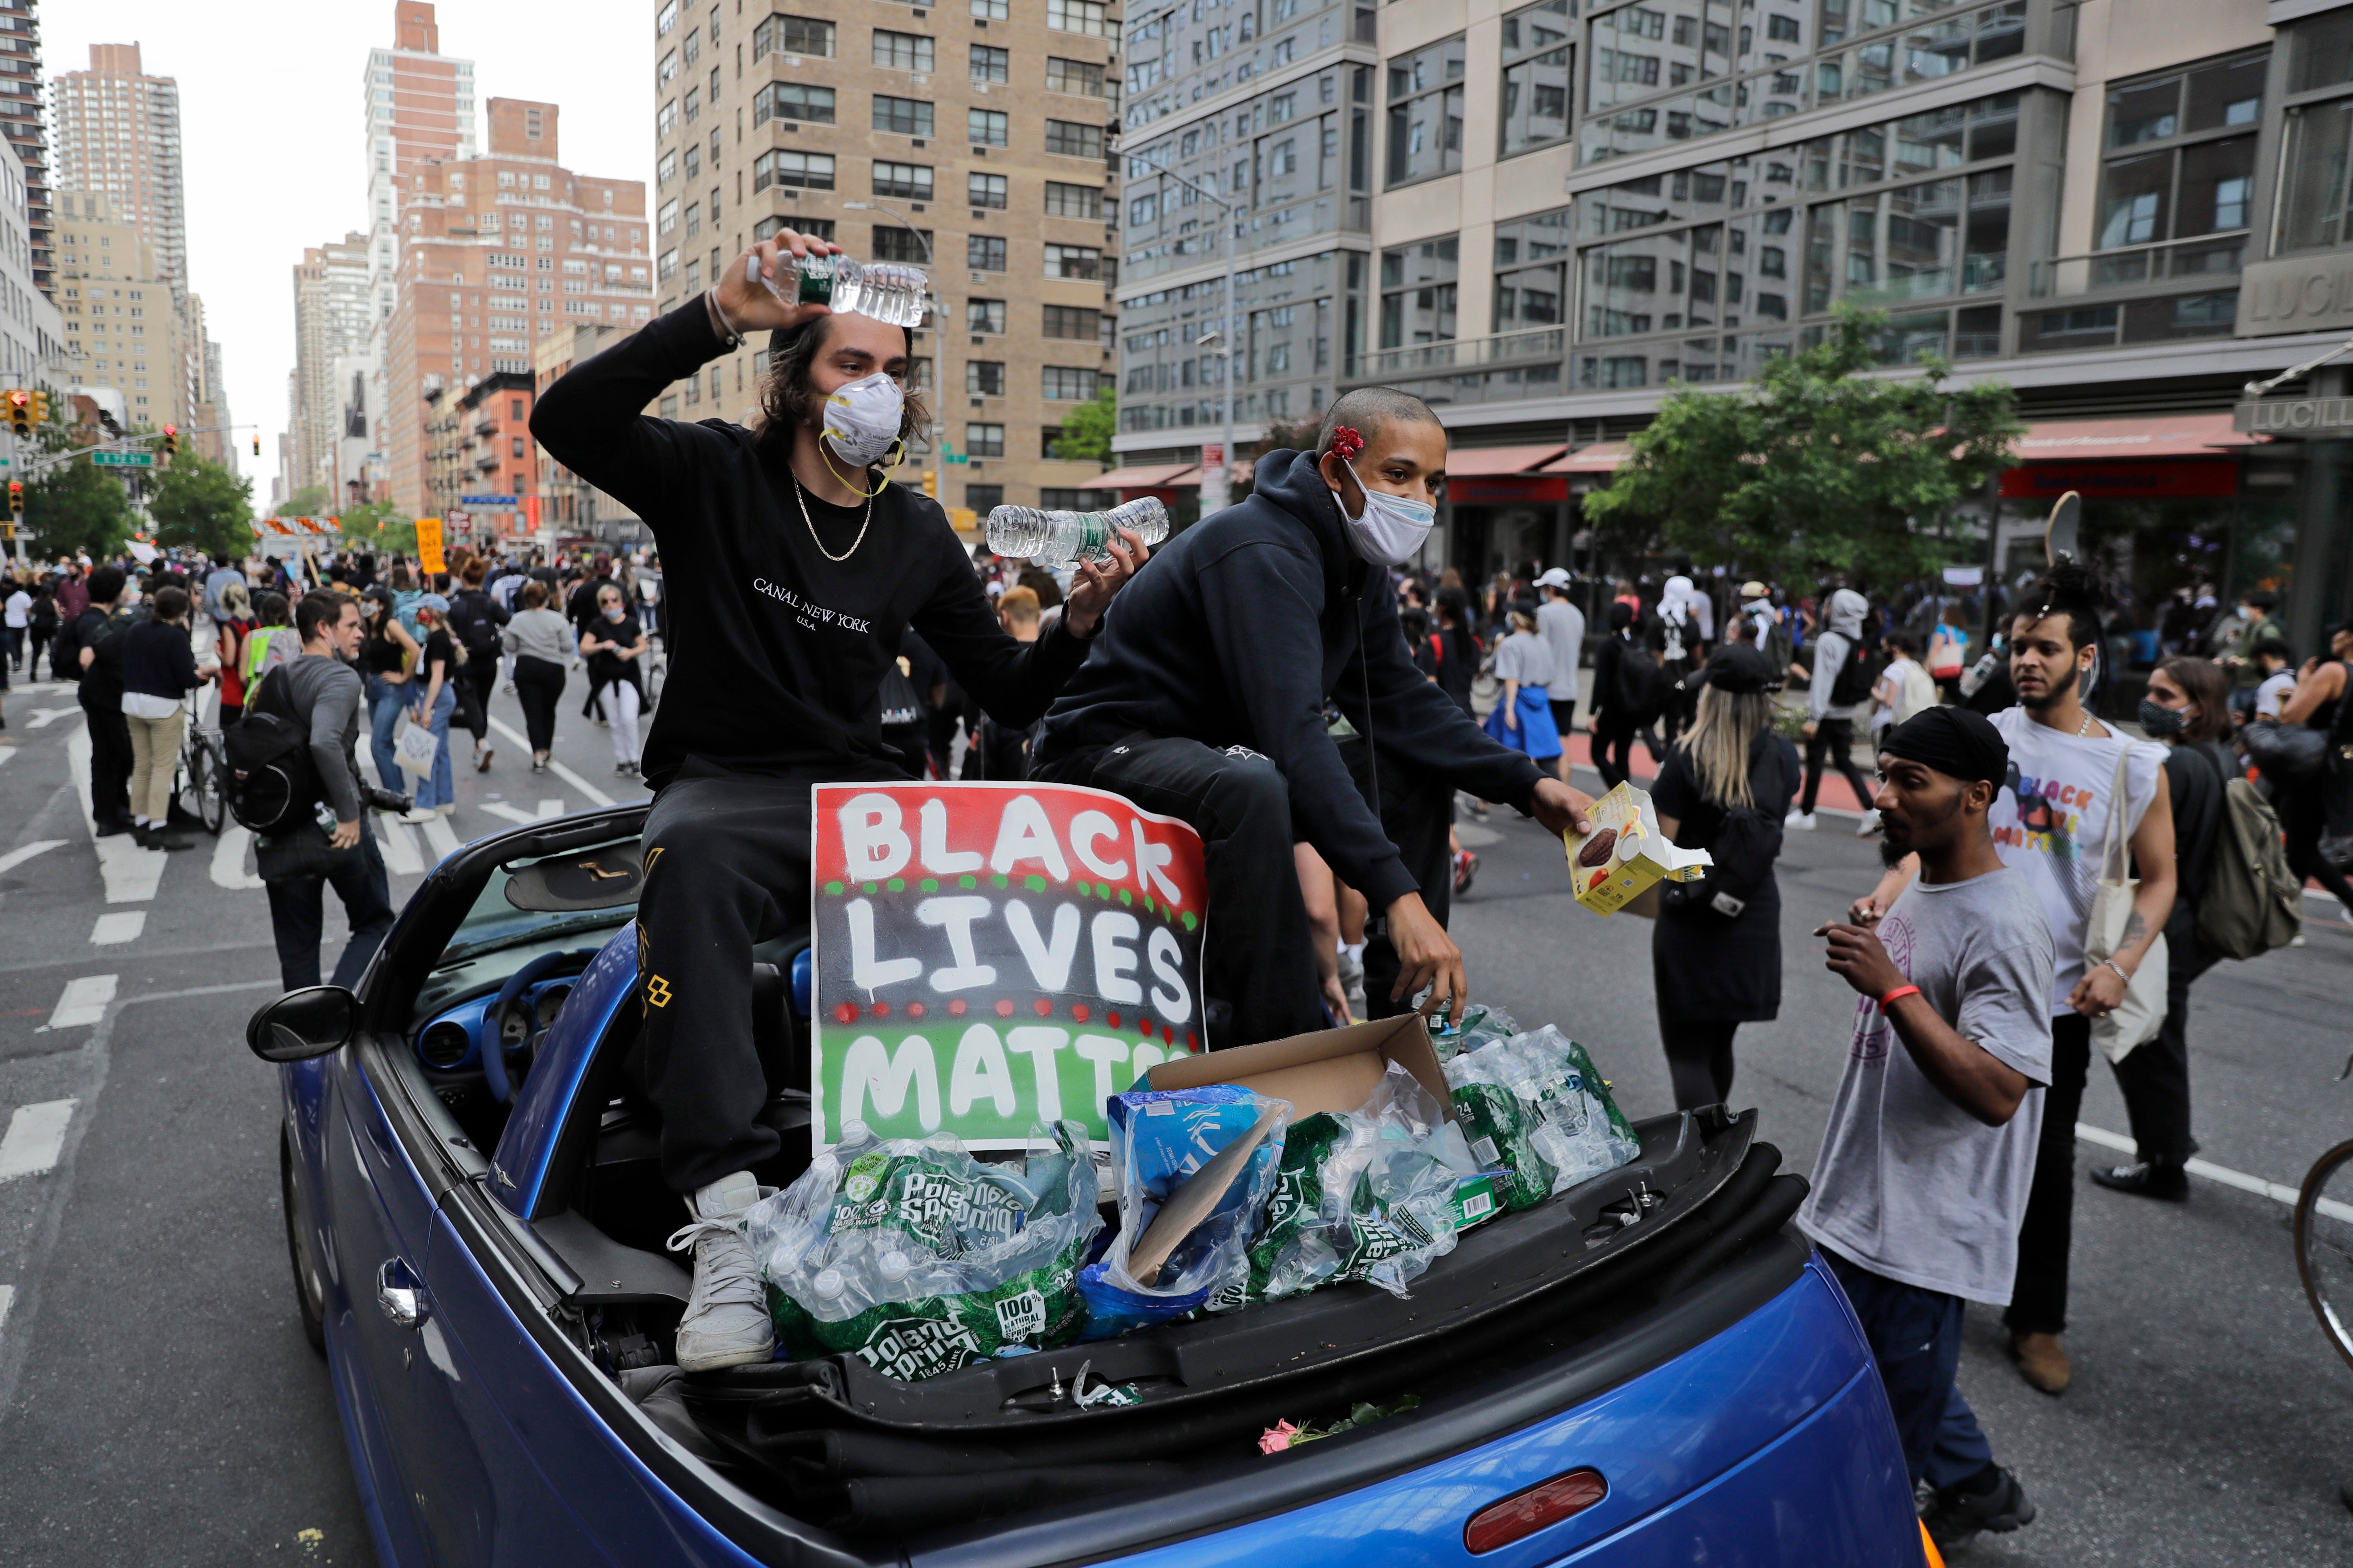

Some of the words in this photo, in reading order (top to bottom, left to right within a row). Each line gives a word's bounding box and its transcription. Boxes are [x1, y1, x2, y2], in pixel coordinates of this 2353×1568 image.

[817, 258, 828, 279] Sprin
[754, 578, 799, 608] CANAL
[801, 601, 836, 623] NEW
[837, 613, 871, 634] YORK
[796, 616, 816, 631] U.S.A.
[2017, 776, 2094, 810] BLACK
[839, 793, 1181, 904] BLACK
[846, 896, 1192, 1024] LIVES
[840, 1023, 1190, 1132] MATT
[1456, 1101, 1472, 1117] 24
[855, 1216, 882, 1224] WATER
[1055, 1268, 1074, 1287] 24
[998, 1293, 1041, 1321] 100%
[1004, 1313, 1041, 1333] NATURAL
[918, 1360, 946, 1379] 1845
